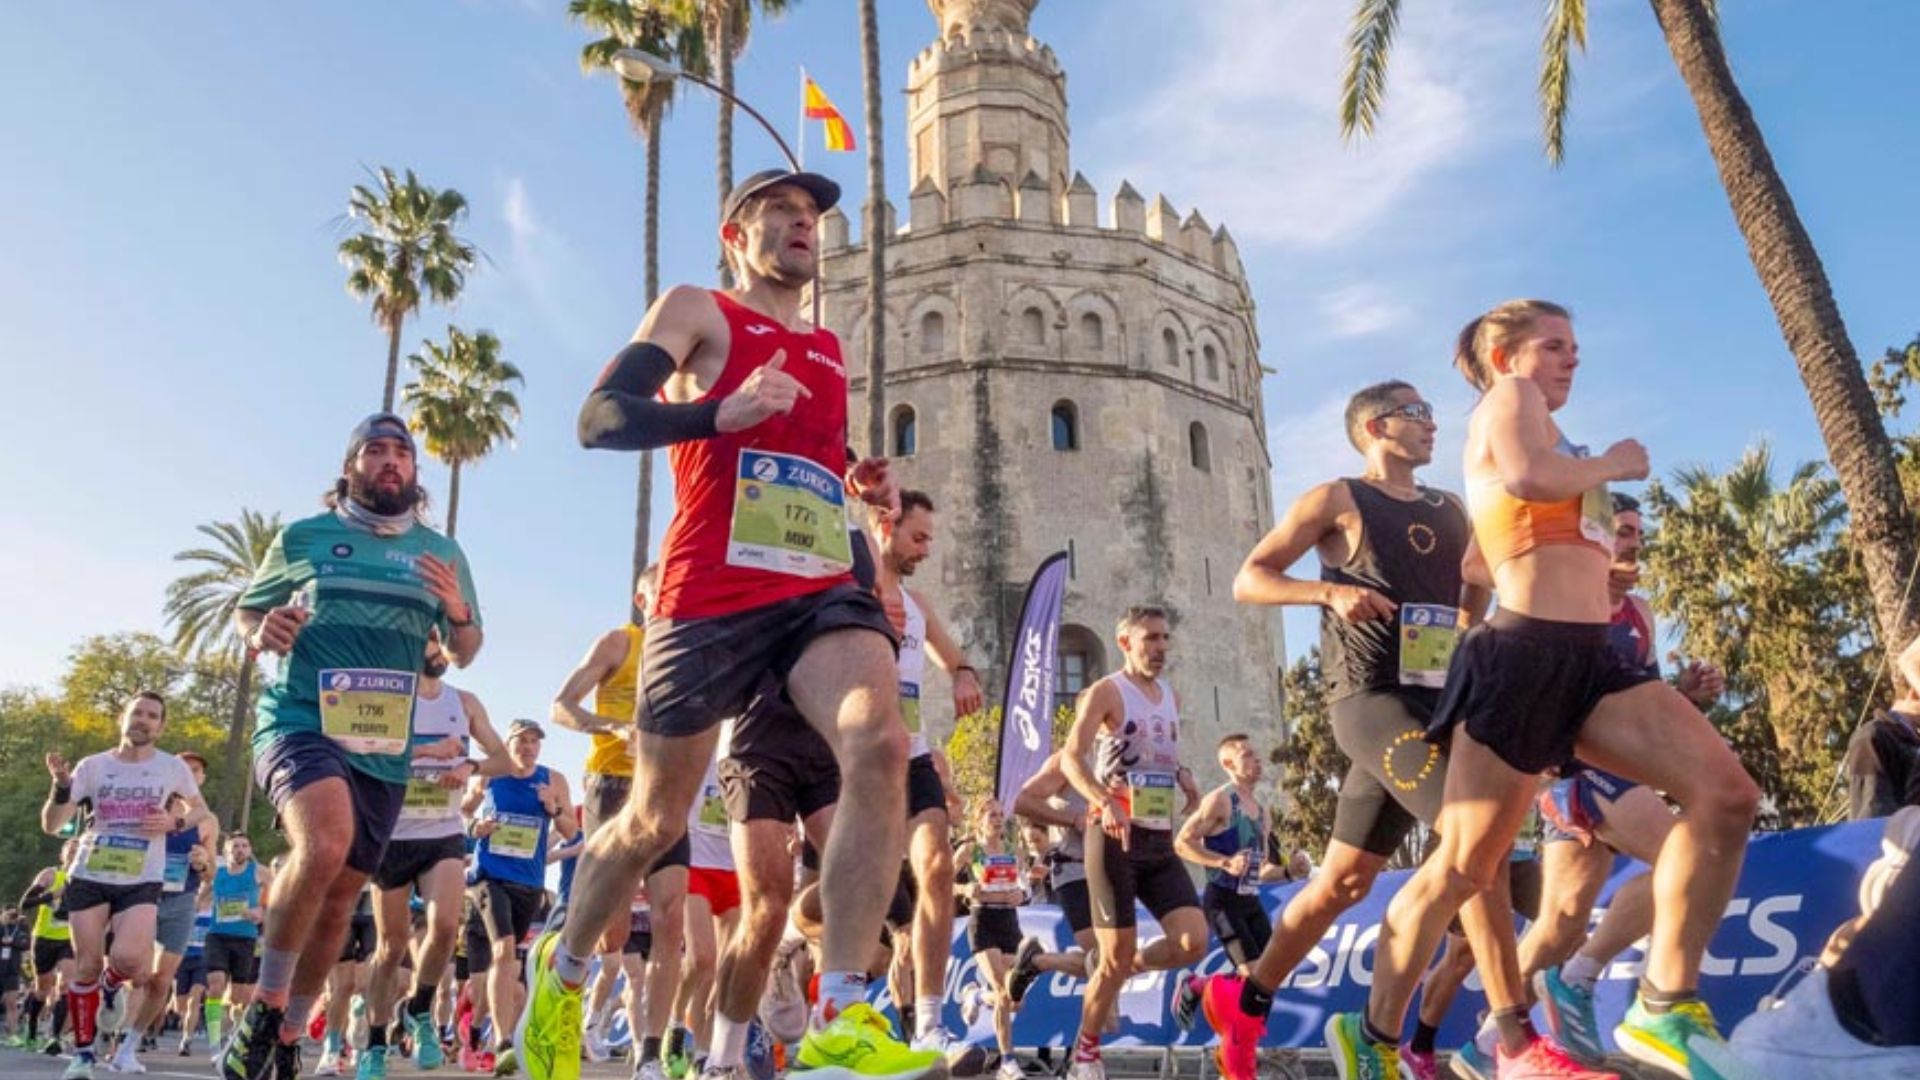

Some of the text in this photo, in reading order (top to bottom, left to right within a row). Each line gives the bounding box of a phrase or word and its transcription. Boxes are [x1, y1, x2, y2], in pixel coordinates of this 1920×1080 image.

[787, 465, 835, 499] ZURICH
[357, 676, 404, 690] ZURICH
[1020, 626, 1041, 710] asics
